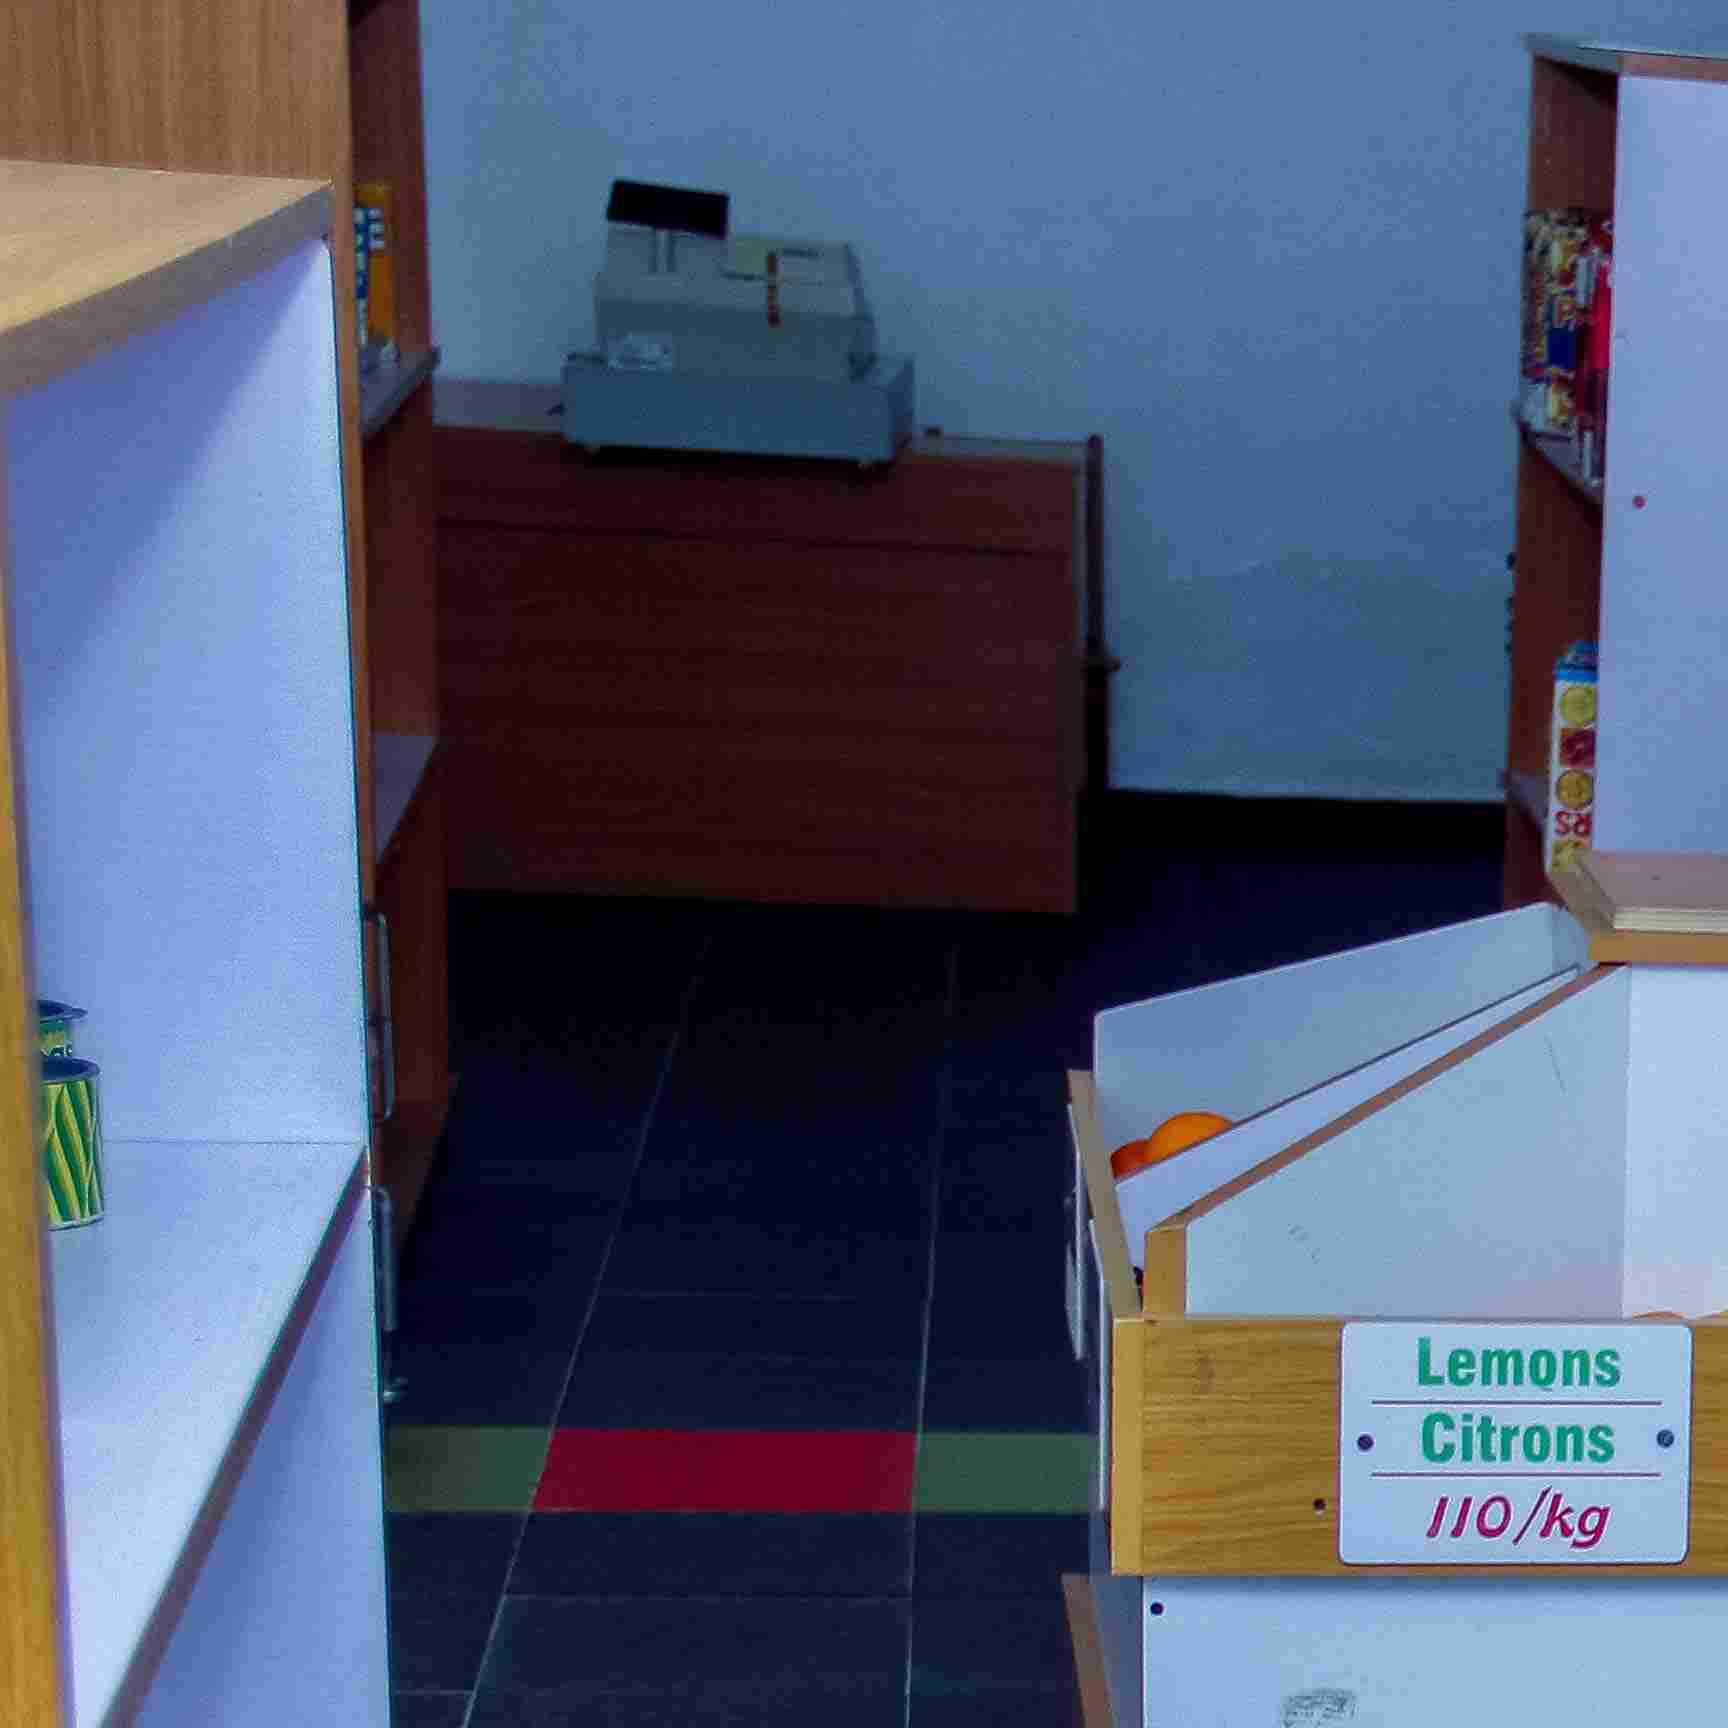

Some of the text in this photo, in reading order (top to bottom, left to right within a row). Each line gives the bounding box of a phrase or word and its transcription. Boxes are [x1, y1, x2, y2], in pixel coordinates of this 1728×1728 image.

[1416, 1336, 1621, 1388] Lemons
[1421, 1411, 1616, 1464] Citrons
[1425, 1485, 1611, 1550] 110/kg
